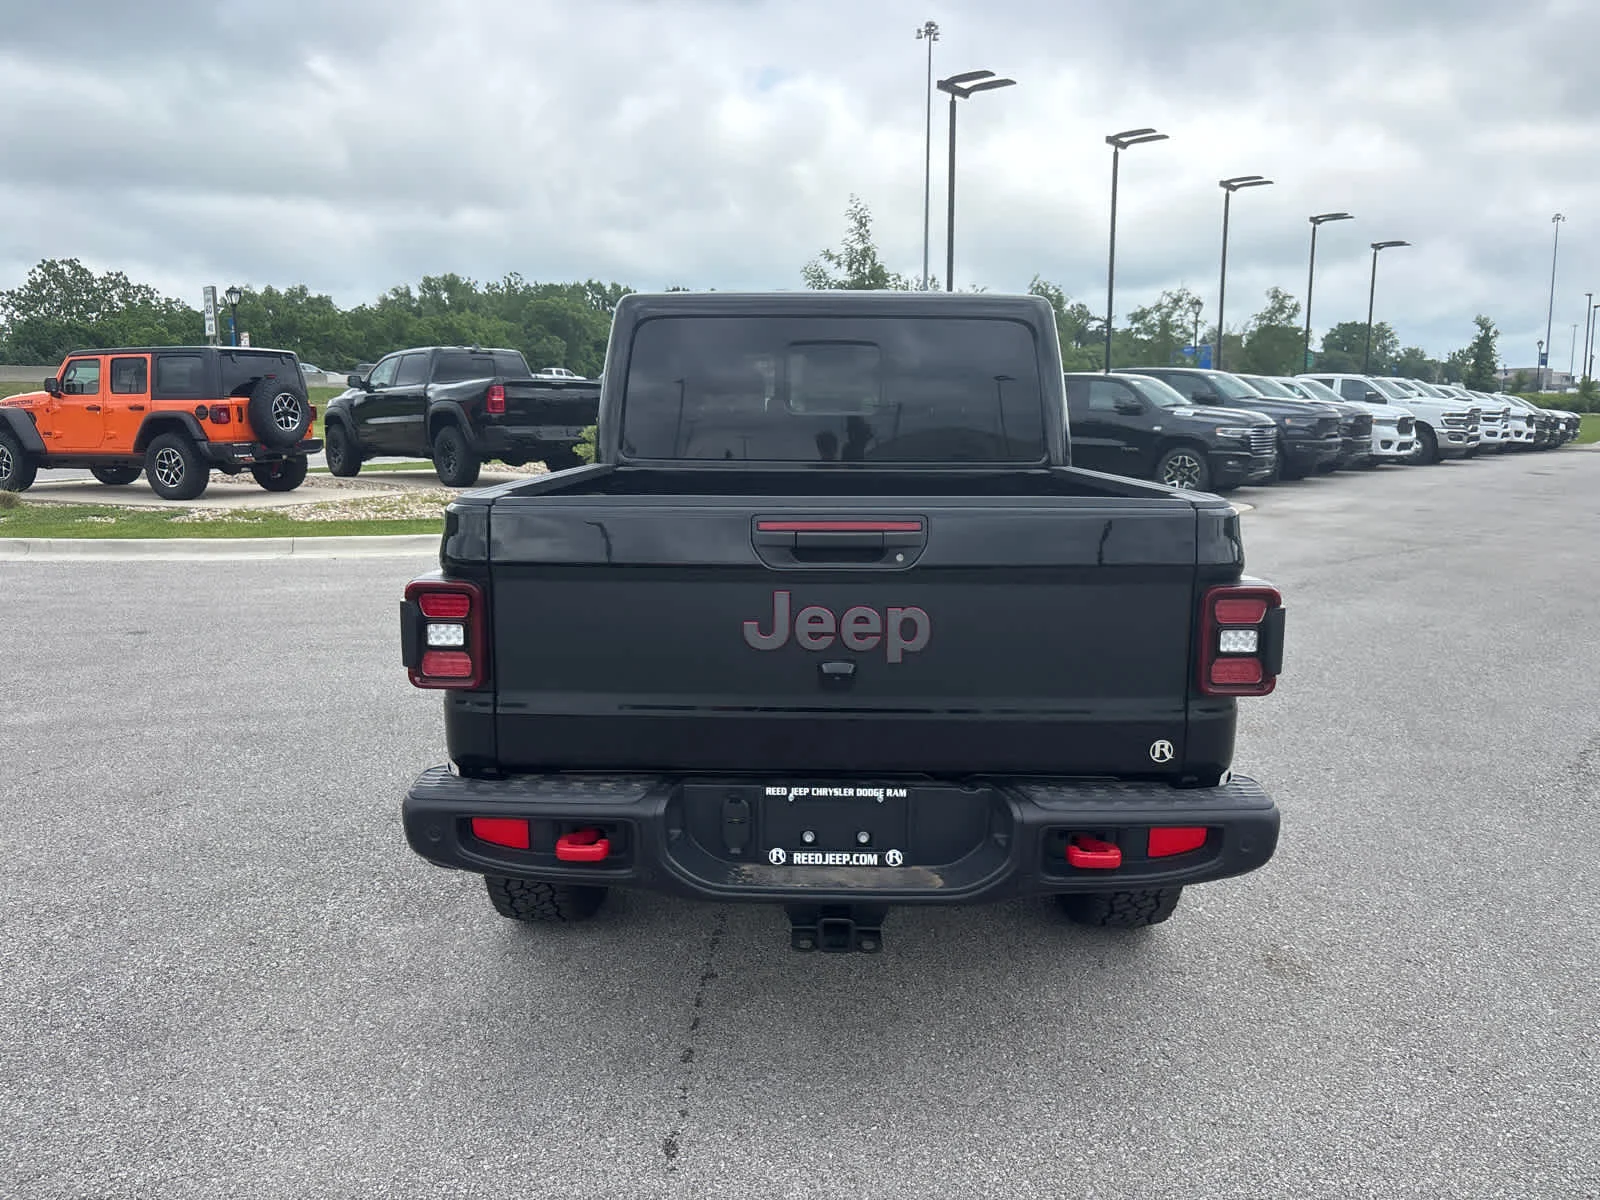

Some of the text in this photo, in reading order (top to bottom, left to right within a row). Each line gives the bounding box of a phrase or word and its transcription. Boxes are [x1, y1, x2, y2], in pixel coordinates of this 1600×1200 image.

[0, 399, 34, 407] UBICON
[743, 590, 931, 663] Jeep
[765, 787, 907, 798] REED JEEP CHRYSLER DODGE RAM
[793, 853, 878, 866] REEDJEEP.COM
